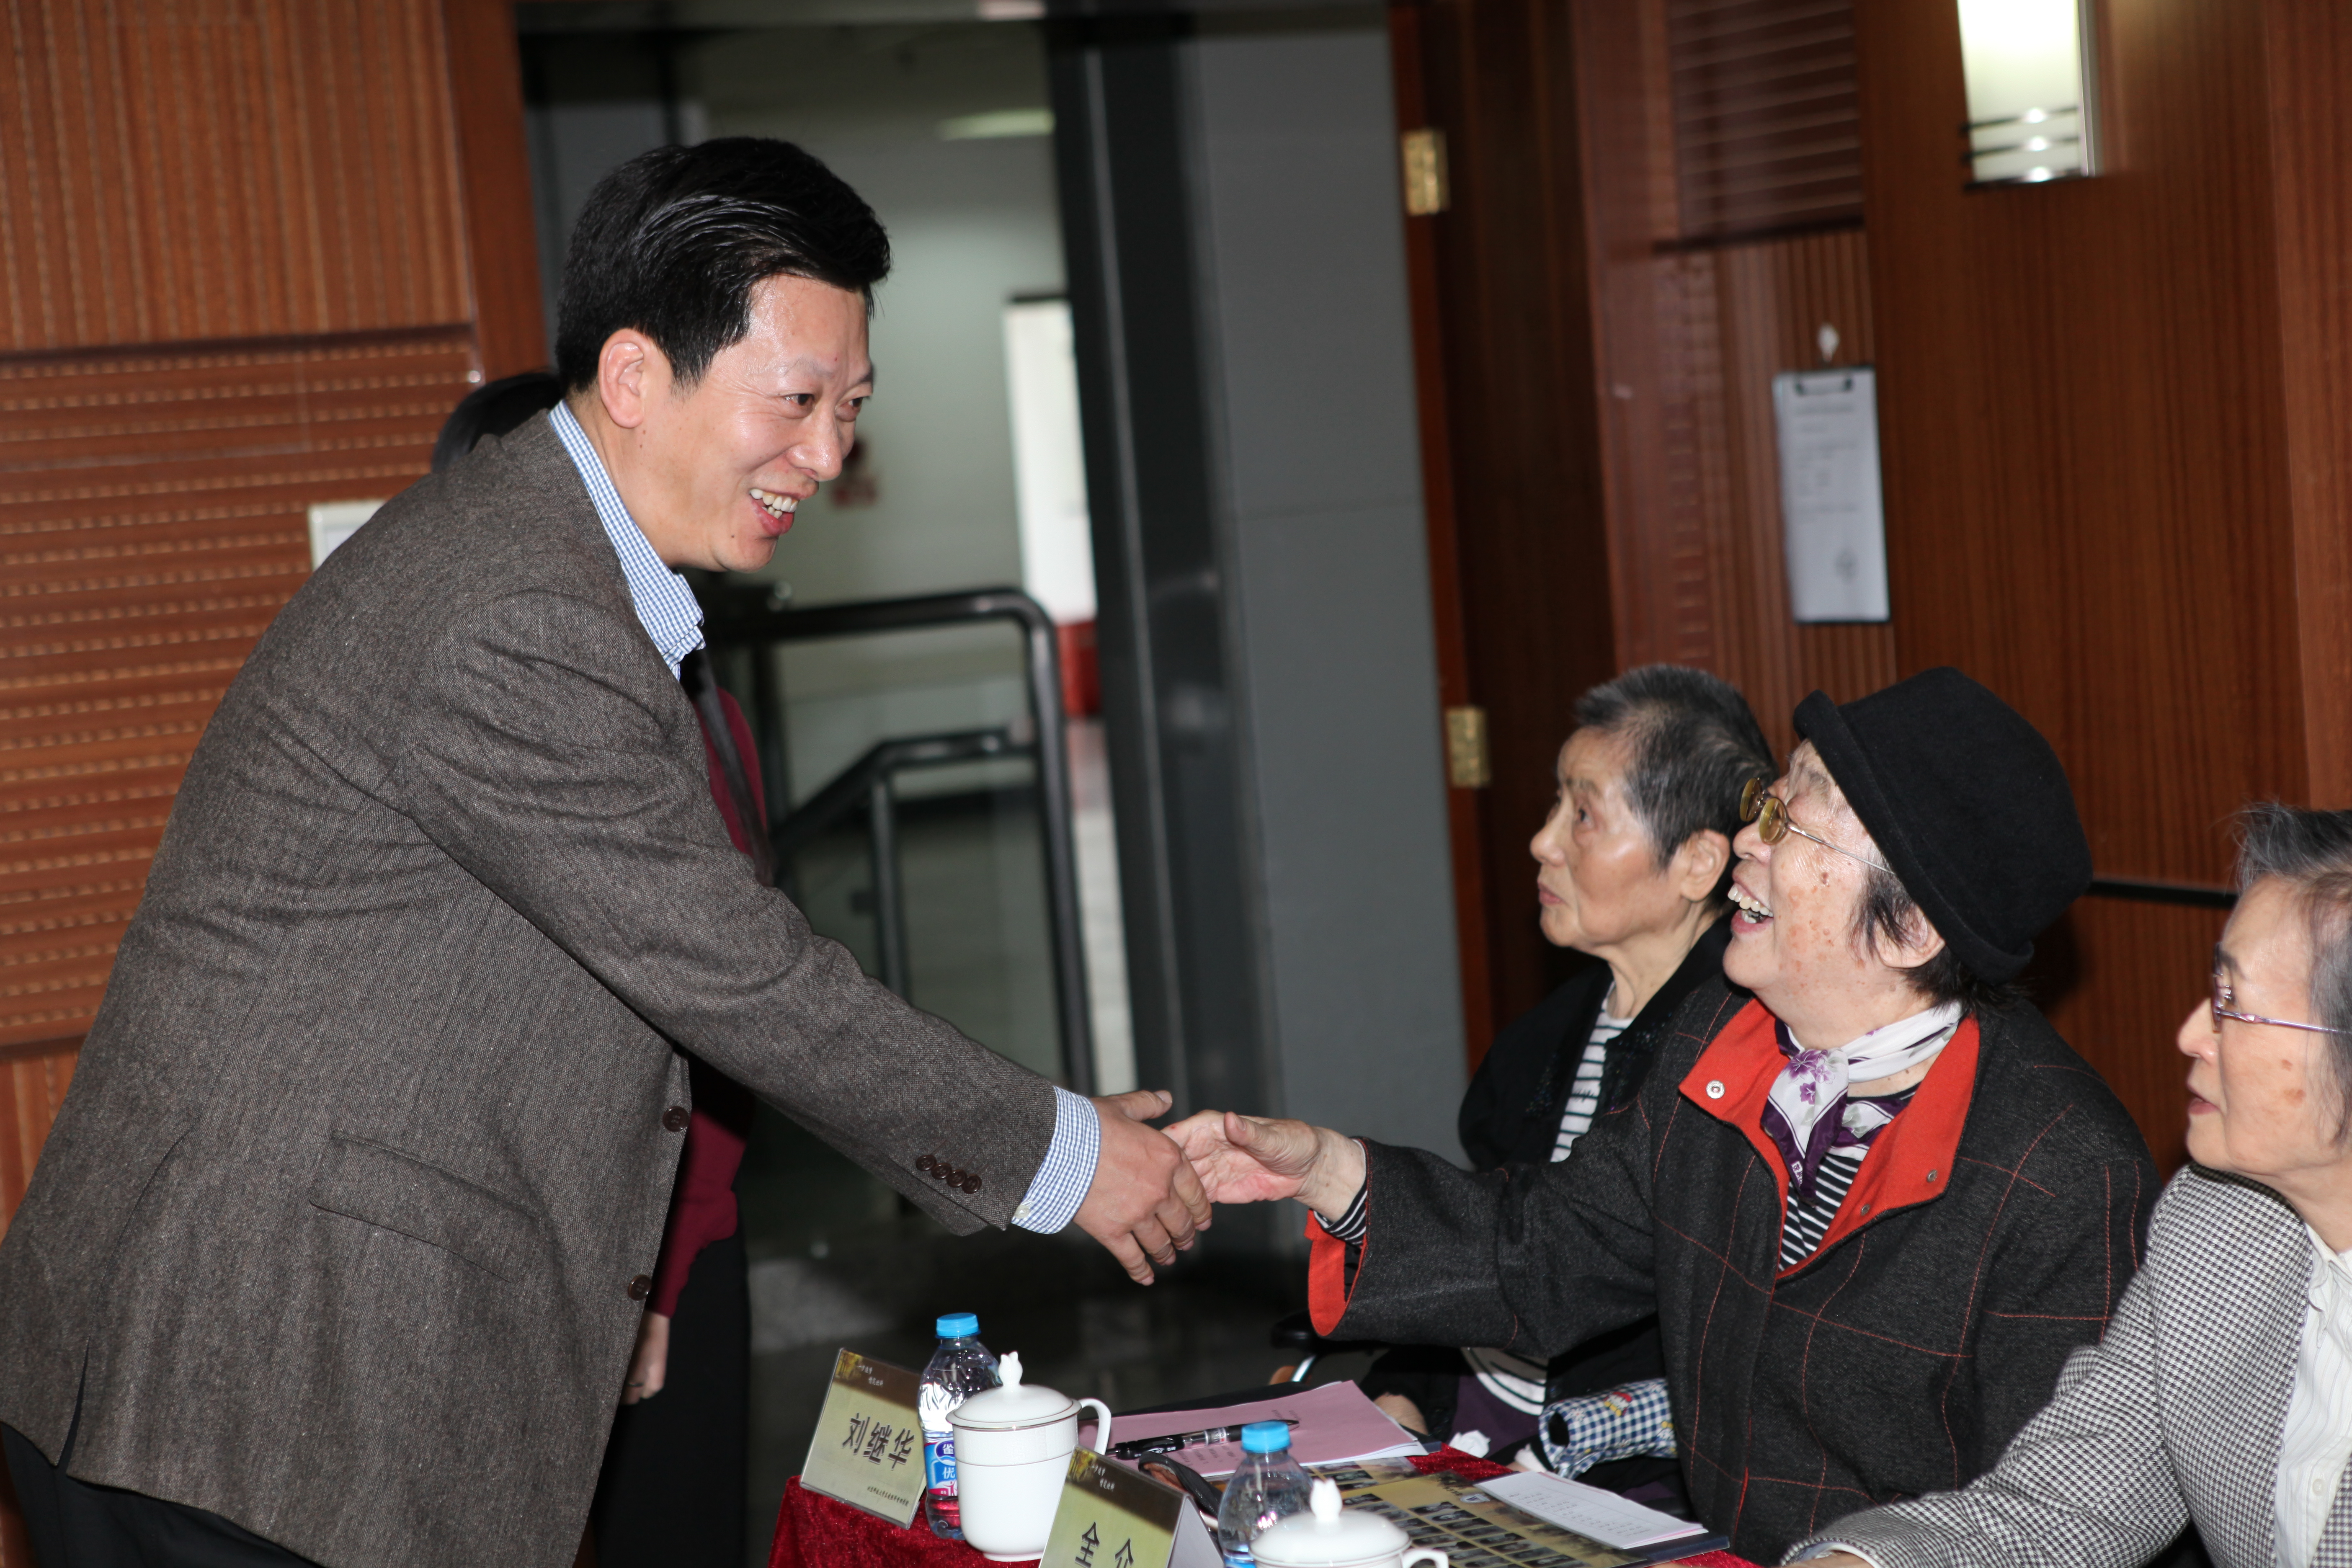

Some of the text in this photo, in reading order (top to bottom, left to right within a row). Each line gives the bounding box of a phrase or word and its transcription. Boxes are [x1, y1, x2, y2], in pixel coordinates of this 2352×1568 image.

[843, 1413, 915, 1470] 刘继华
[942, 1444, 954, 1455] 雀
[942, 1467, 955, 1479] 优
